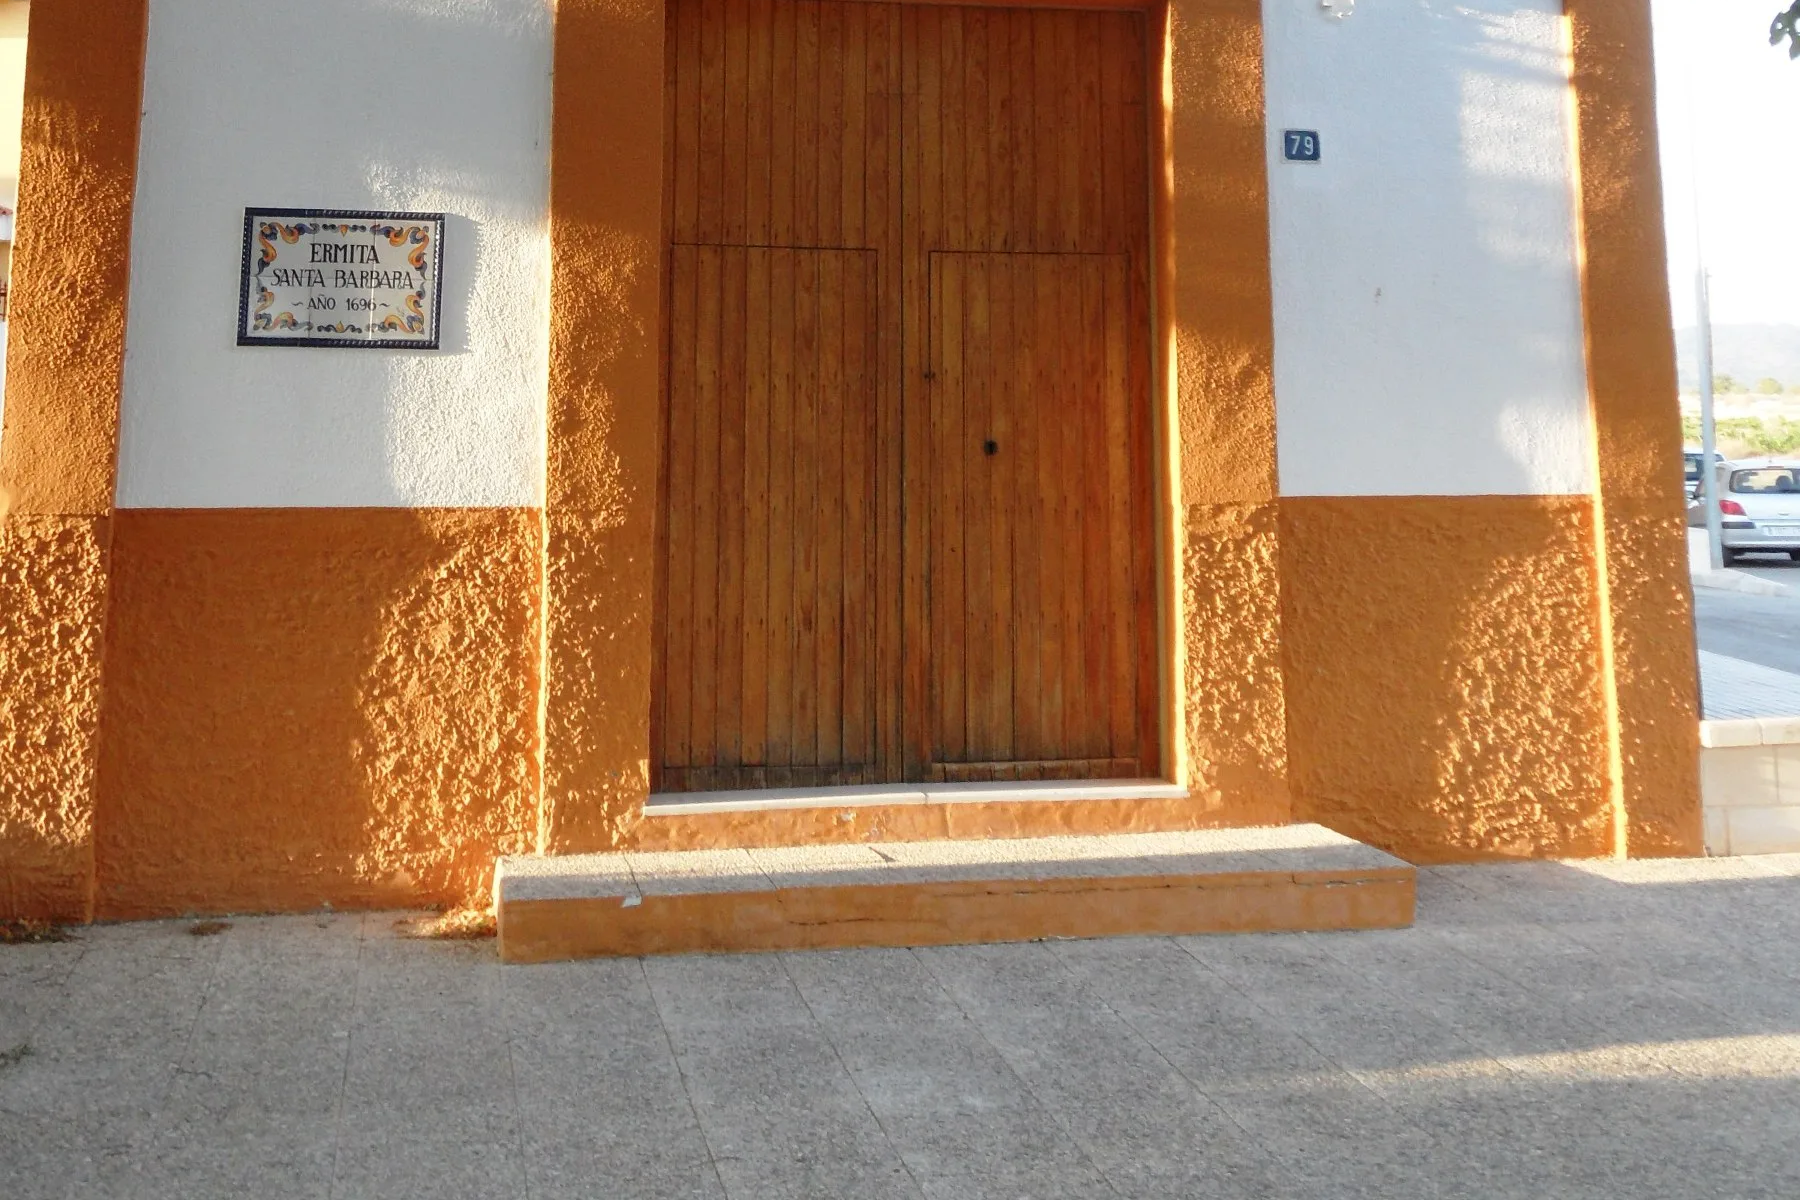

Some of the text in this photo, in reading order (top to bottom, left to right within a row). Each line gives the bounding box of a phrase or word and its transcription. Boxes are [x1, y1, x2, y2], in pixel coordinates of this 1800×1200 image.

[1290, 135, 1314, 156] 79
[310, 243, 380, 264] ERMITA
[270, 268, 414, 290] SANTA BARBARA
[306, 295, 377, 311] AÑO 1696
